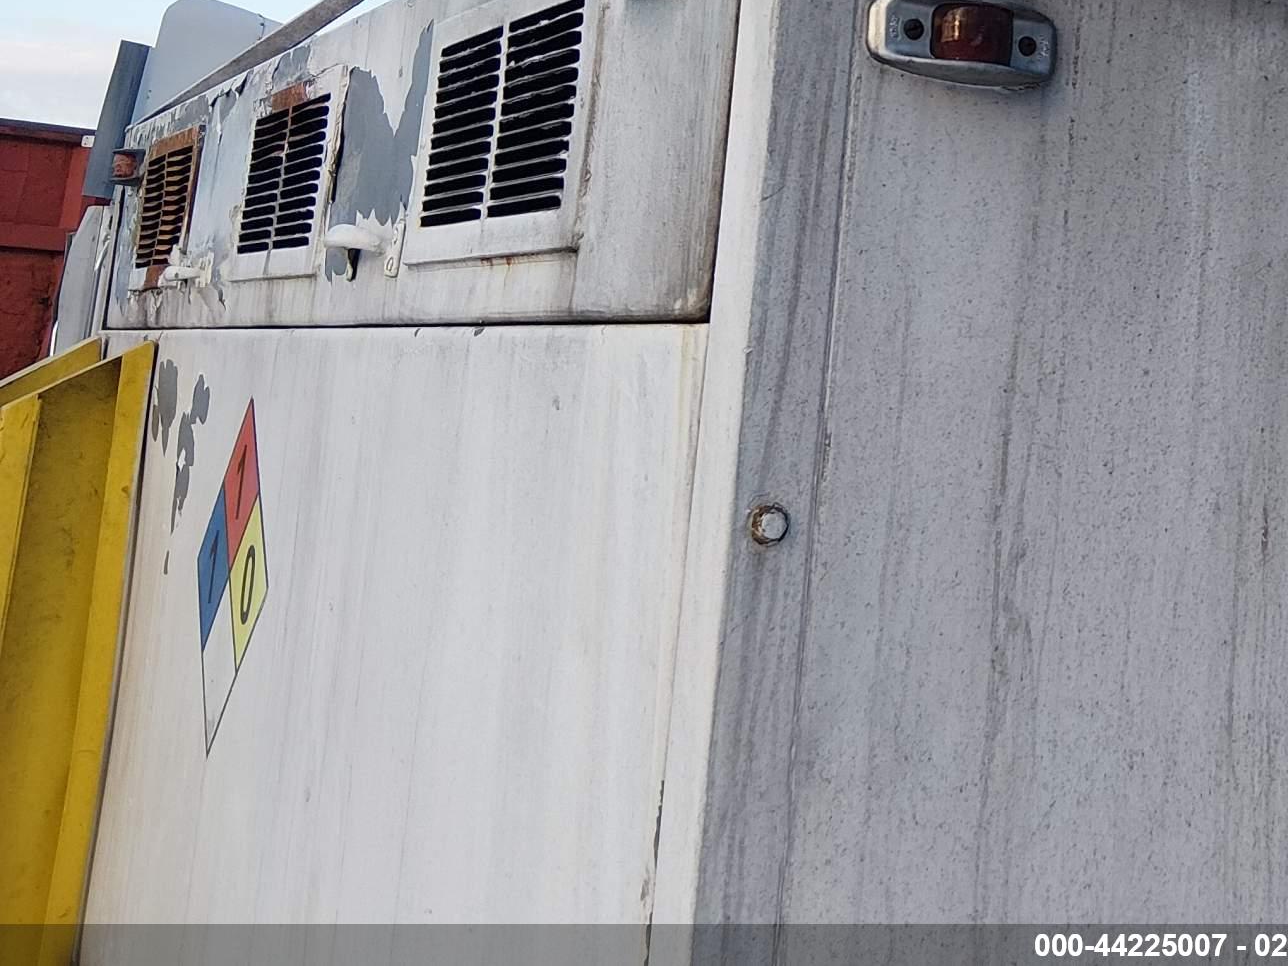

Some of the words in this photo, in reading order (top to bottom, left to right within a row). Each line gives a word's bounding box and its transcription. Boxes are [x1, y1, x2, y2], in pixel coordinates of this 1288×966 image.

[235, 444, 247, 520] 1
[208, 529, 220, 603] 1
[240, 545, 255, 625] 0
